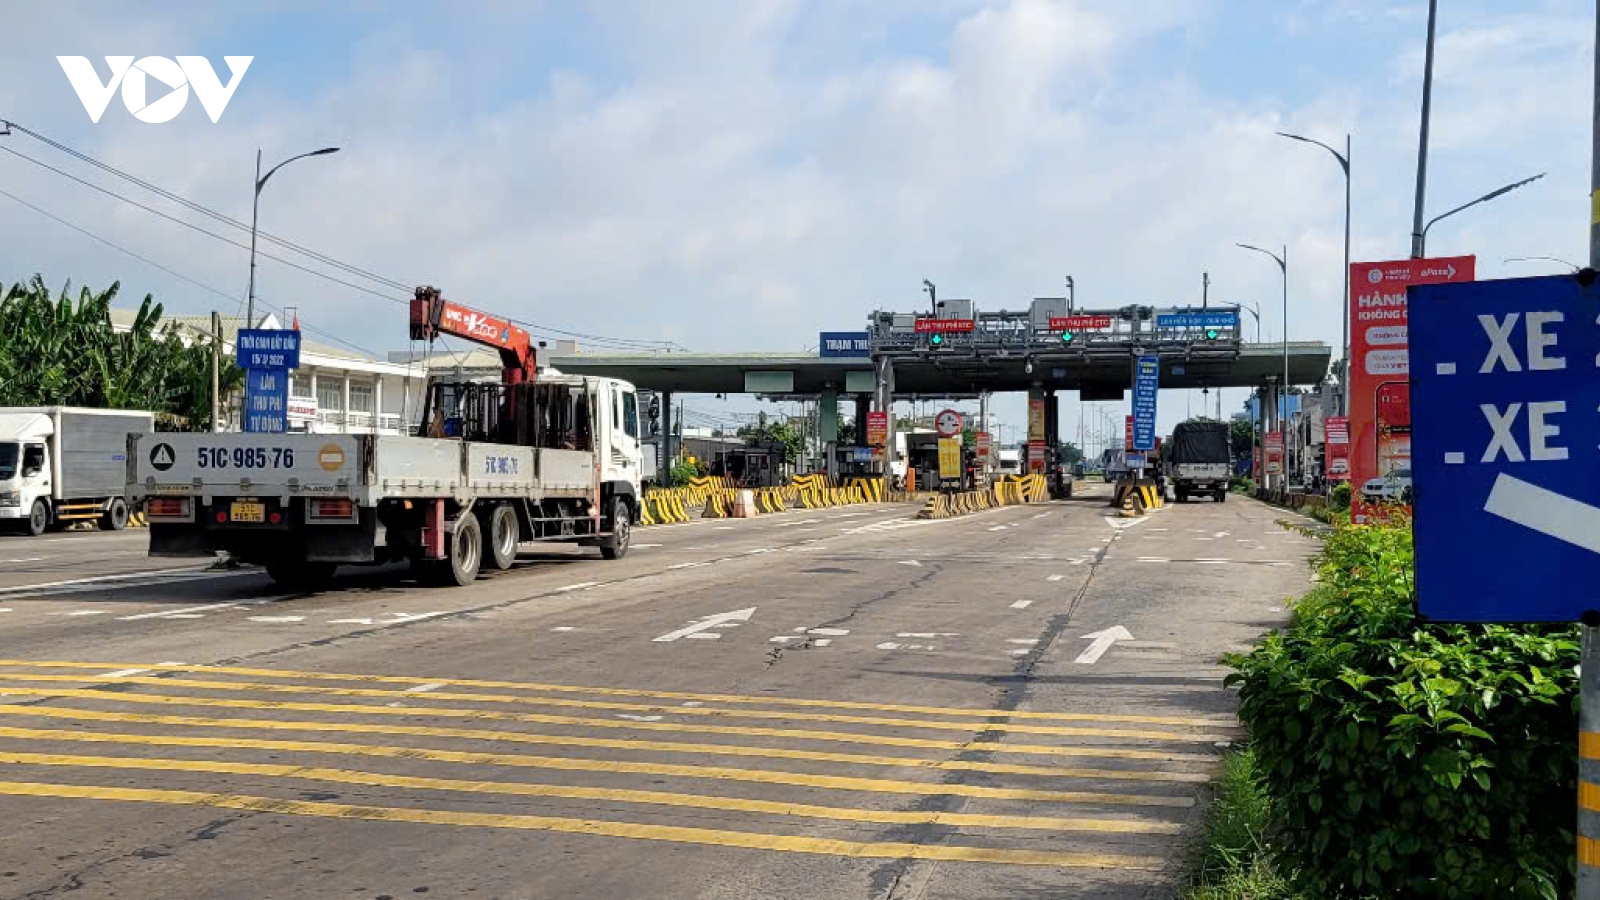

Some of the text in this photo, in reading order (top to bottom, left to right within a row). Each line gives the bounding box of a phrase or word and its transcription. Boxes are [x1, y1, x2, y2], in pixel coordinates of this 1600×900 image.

[1358, 291, 1407, 307] HÀNH
[1358, 309, 1400, 320] KHÔNG
[932, 322, 944, 330] THU
[825, 339, 851, 353] TRẠM
[1477, 311, 1567, 374] XE
[261, 373, 275, 391] LÀN
[253, 395, 267, 411] THU
[269, 393, 282, 411] PHÍ
[1479, 400, 1569, 463] XE
